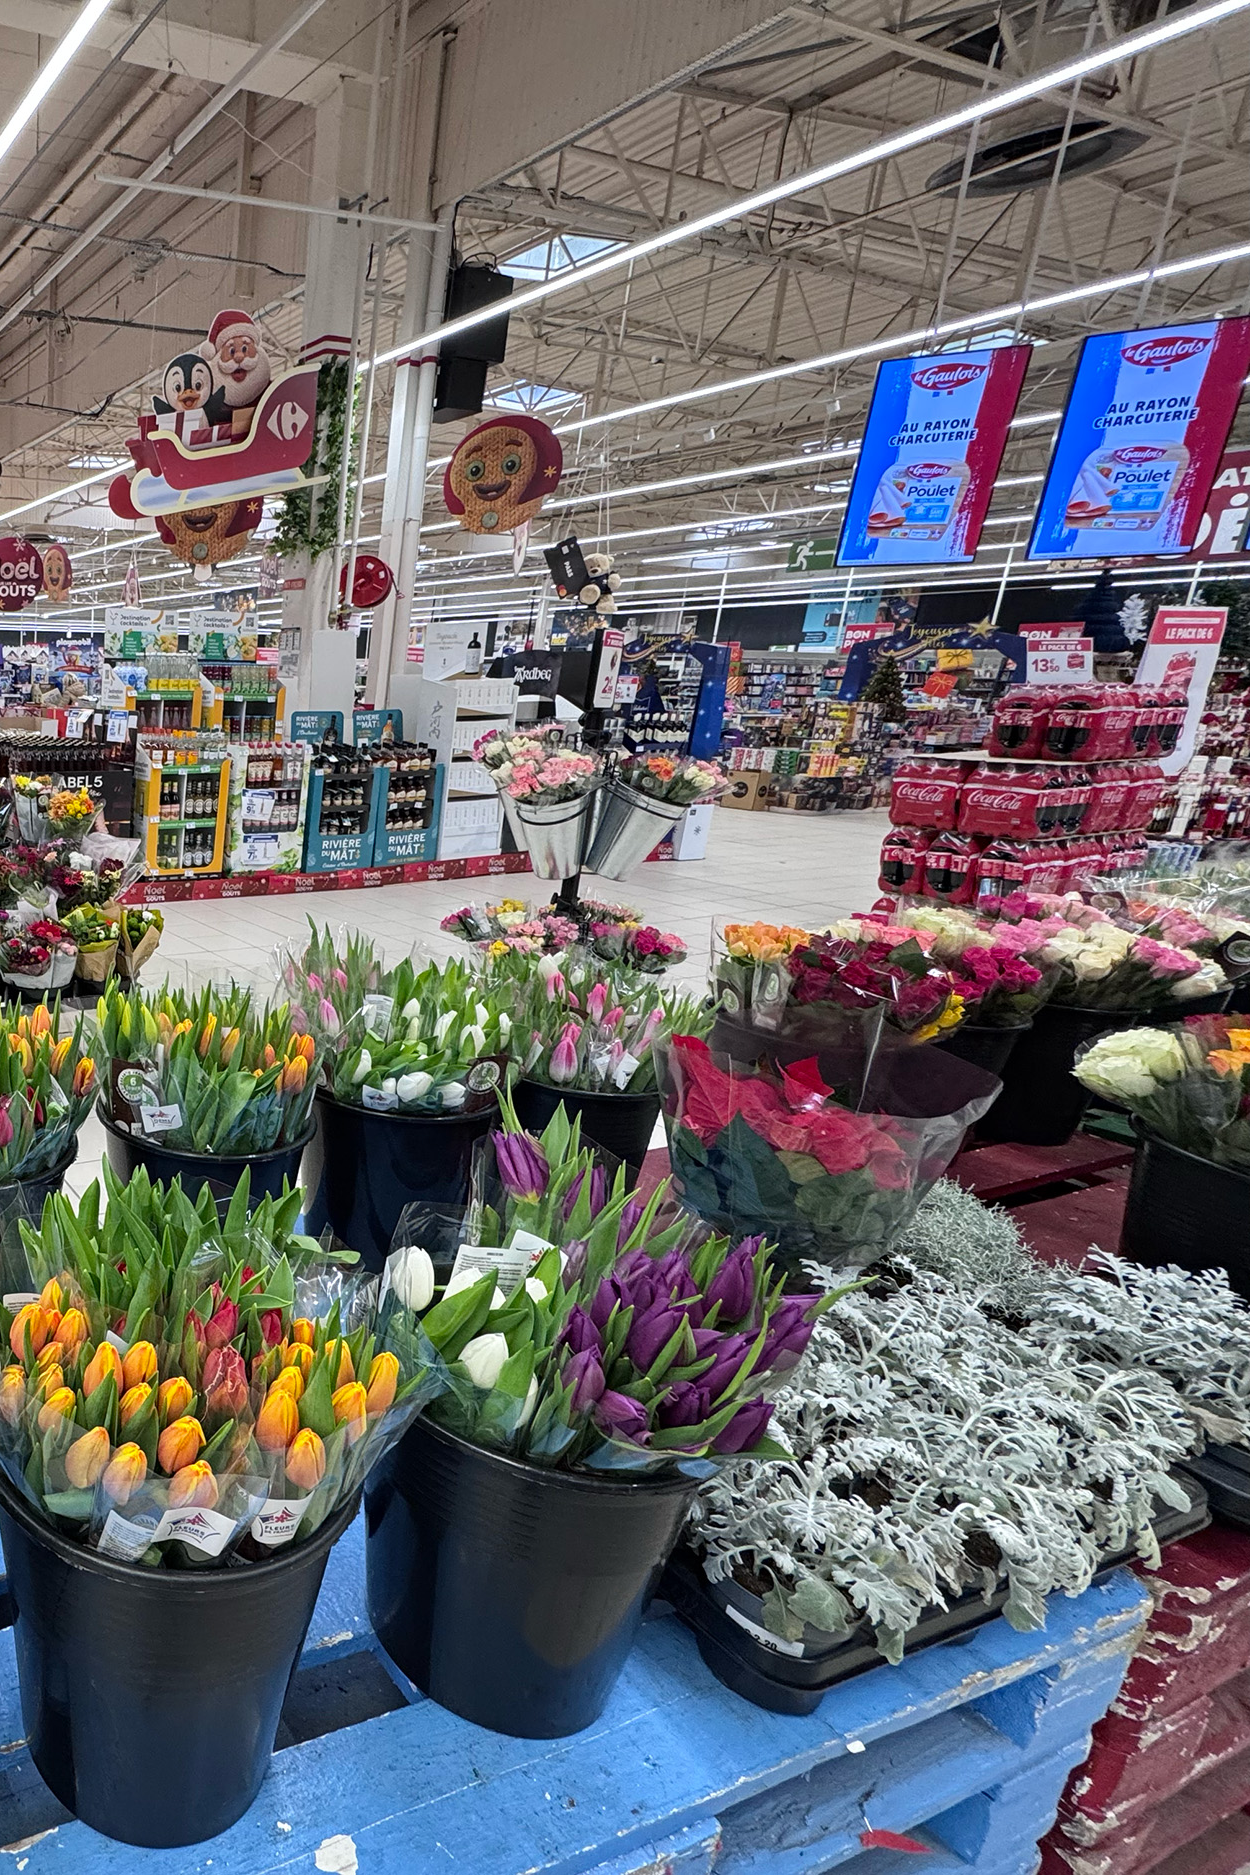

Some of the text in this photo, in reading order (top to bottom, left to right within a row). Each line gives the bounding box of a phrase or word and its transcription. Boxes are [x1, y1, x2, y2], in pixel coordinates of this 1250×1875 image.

[1133, 339, 1204, 363] Gaulois
[921, 366, 981, 388] Gaulois
[1107, 396, 1191, 414] AU RAYON
[1094, 408, 1197, 428] CHARCUTERIE
[900, 418, 970, 433] AU RAYON
[889, 429, 977, 446] CHARCUTERIE
[1114, 469, 1172, 484] Poulet
[907, 485, 956, 497] Poulet
[563, 560, 574, 578] PASS
[846, 630, 870, 640] BON
[908, 622, 959, 641] Joyeuses
[56, 637, 92, 647] playmobil
[322, 837, 361, 849] RIVIÈRE
[389, 833, 426, 845] RIVIÈRE
[321, 847, 355, 861] DU MÂT
[396, 844, 420, 856] MÂT
[130, 1077, 136, 1086] 6
[173, 1525, 205, 1537] FLEURS
[264, 1524, 295, 1532] FLEURS
